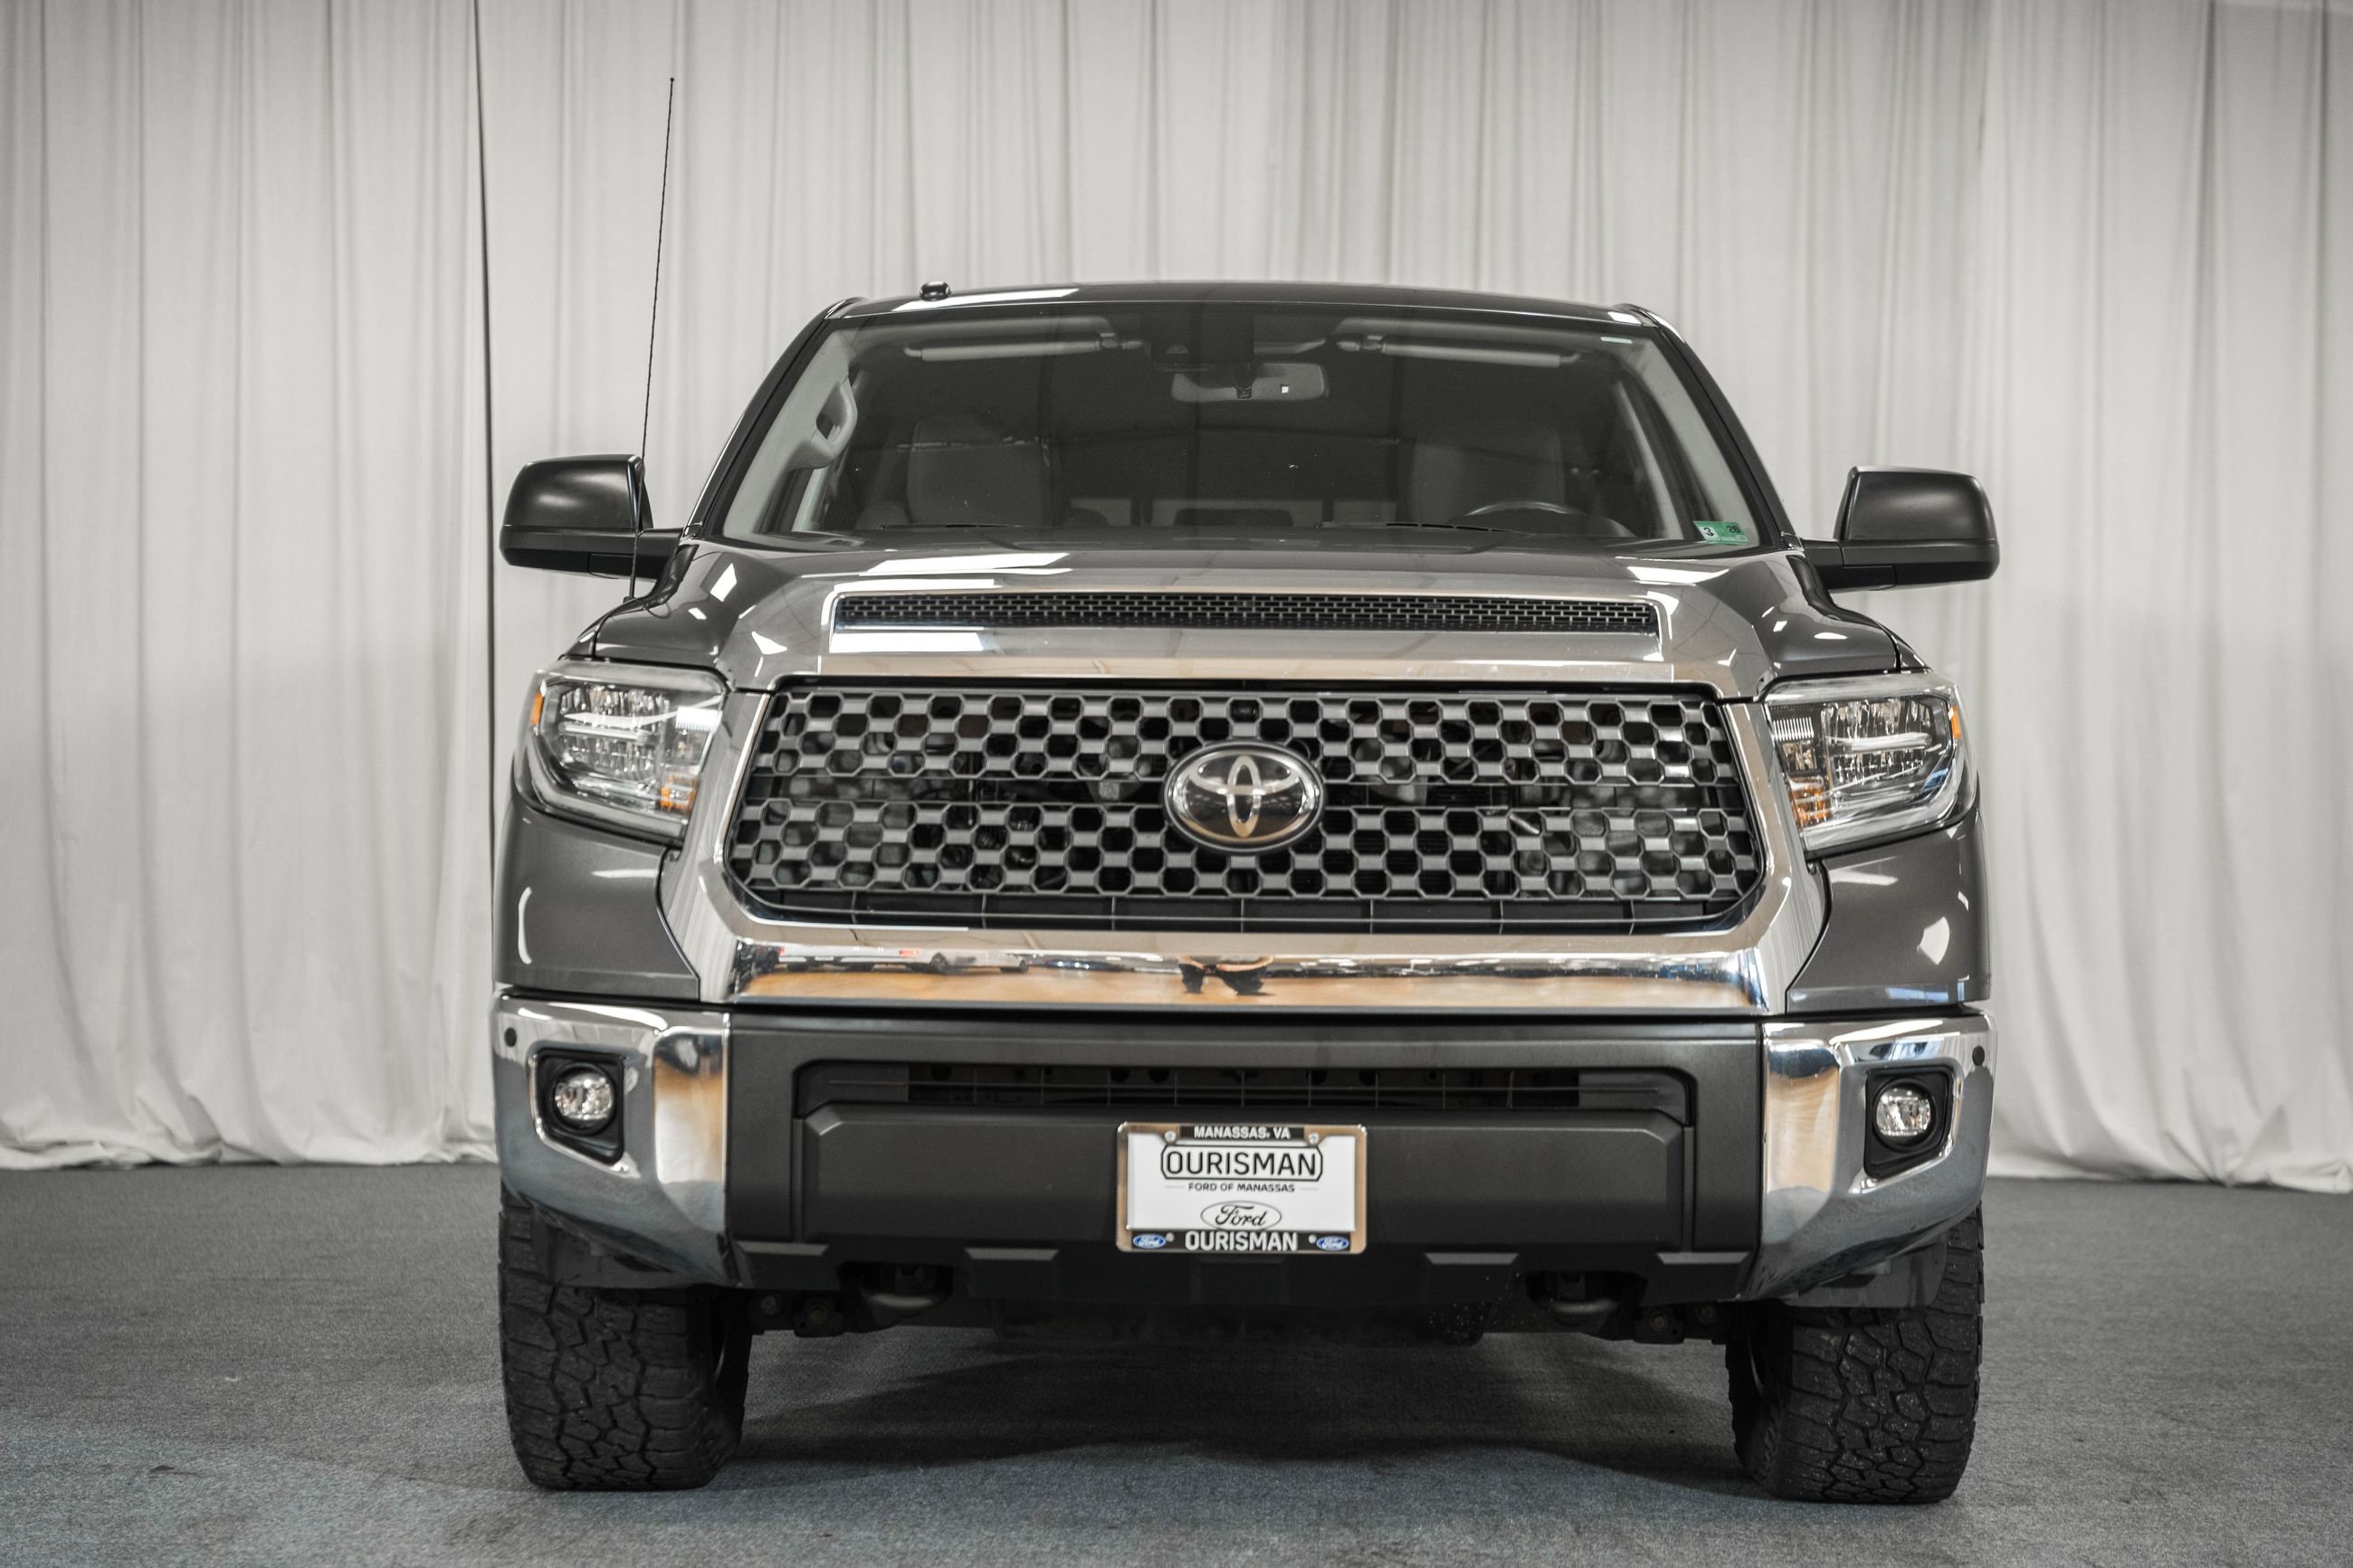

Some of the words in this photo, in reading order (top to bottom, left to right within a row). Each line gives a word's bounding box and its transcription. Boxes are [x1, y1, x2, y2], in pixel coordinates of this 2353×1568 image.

[1703, 527, 1714, 537] 3
[1272, 1127, 1291, 1139] VA
[1167, 1151, 1316, 1176] OURISMAN
[1188, 1182, 1217, 1192] FORD
[1220, 1183, 1234, 1192] OF
[1236, 1183, 1295, 1193] MANASSAS
[1215, 1204, 1268, 1226] Ford
[1185, 1231, 1298, 1251] OURISMAN
